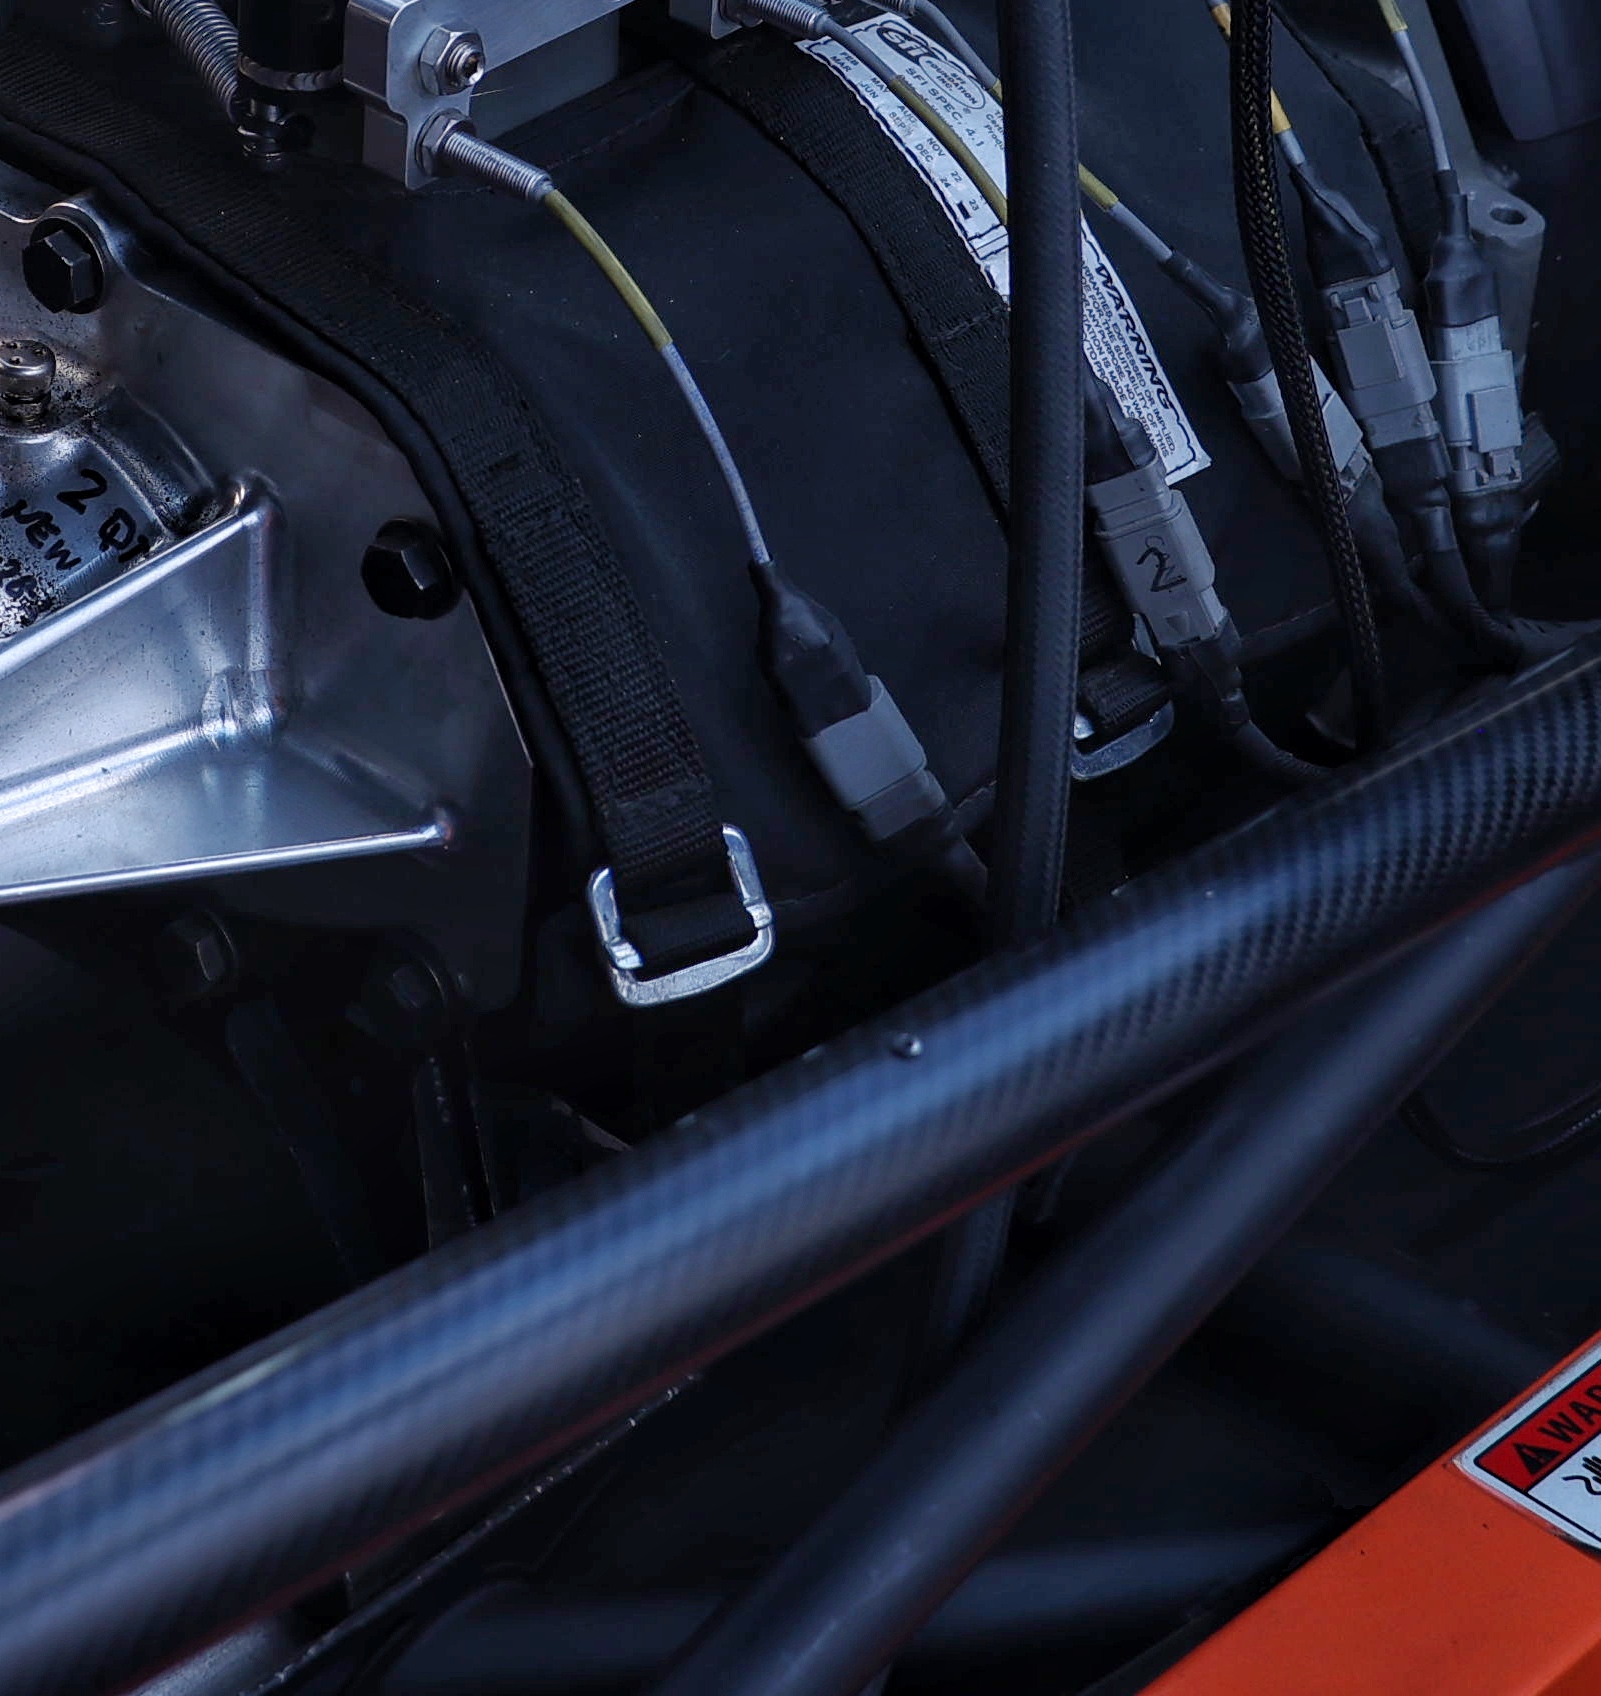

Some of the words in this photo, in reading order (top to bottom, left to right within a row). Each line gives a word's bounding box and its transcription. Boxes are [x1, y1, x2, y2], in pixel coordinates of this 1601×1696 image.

[830, 52, 851, 73] MAR
[860, 79, 879, 100] JUN
[888, 109, 907, 129] SEP
[914, 141, 934, 163] DEC
[904, 64, 928, 87] SFI
[963, 124, 985, 148] 4.1
[924, 57, 977, 107] FOUNDATION
[839, 49, 858, 67] FEB
[870, 75, 889, 94] MAY
[896, 102, 918, 124] AUG
[925, 135, 947, 159] NOV
[949, 168, 963, 183] 22
[967, 197, 980, 212] 23
[1078, 259, 1114, 322] ARRANTIES,
[1110, 321, 1148, 388] EXPRESSED
[1143, 388, 1157, 407] OR
[1151, 406, 1179, 454] IMPLIED.
[1085, 306, 1101, 331] ANY
[1122, 382, 1136, 401] NO
[1087, 293, 1104, 319] FOR
[1100, 319, 1116, 344] THE
[1111, 343, 1149, 411] SUITABILITY
[1144, 412, 1158, 431] OF
[1153, 431, 1170, 458] THIS
[1092, 263, 1177, 412] WARNING
[1100, 356, 1112, 370] IS
[1107, 369, 1128, 403] MADE
[1, 499, 82, 570] NEW
[57, 468, 107, 515] 2
